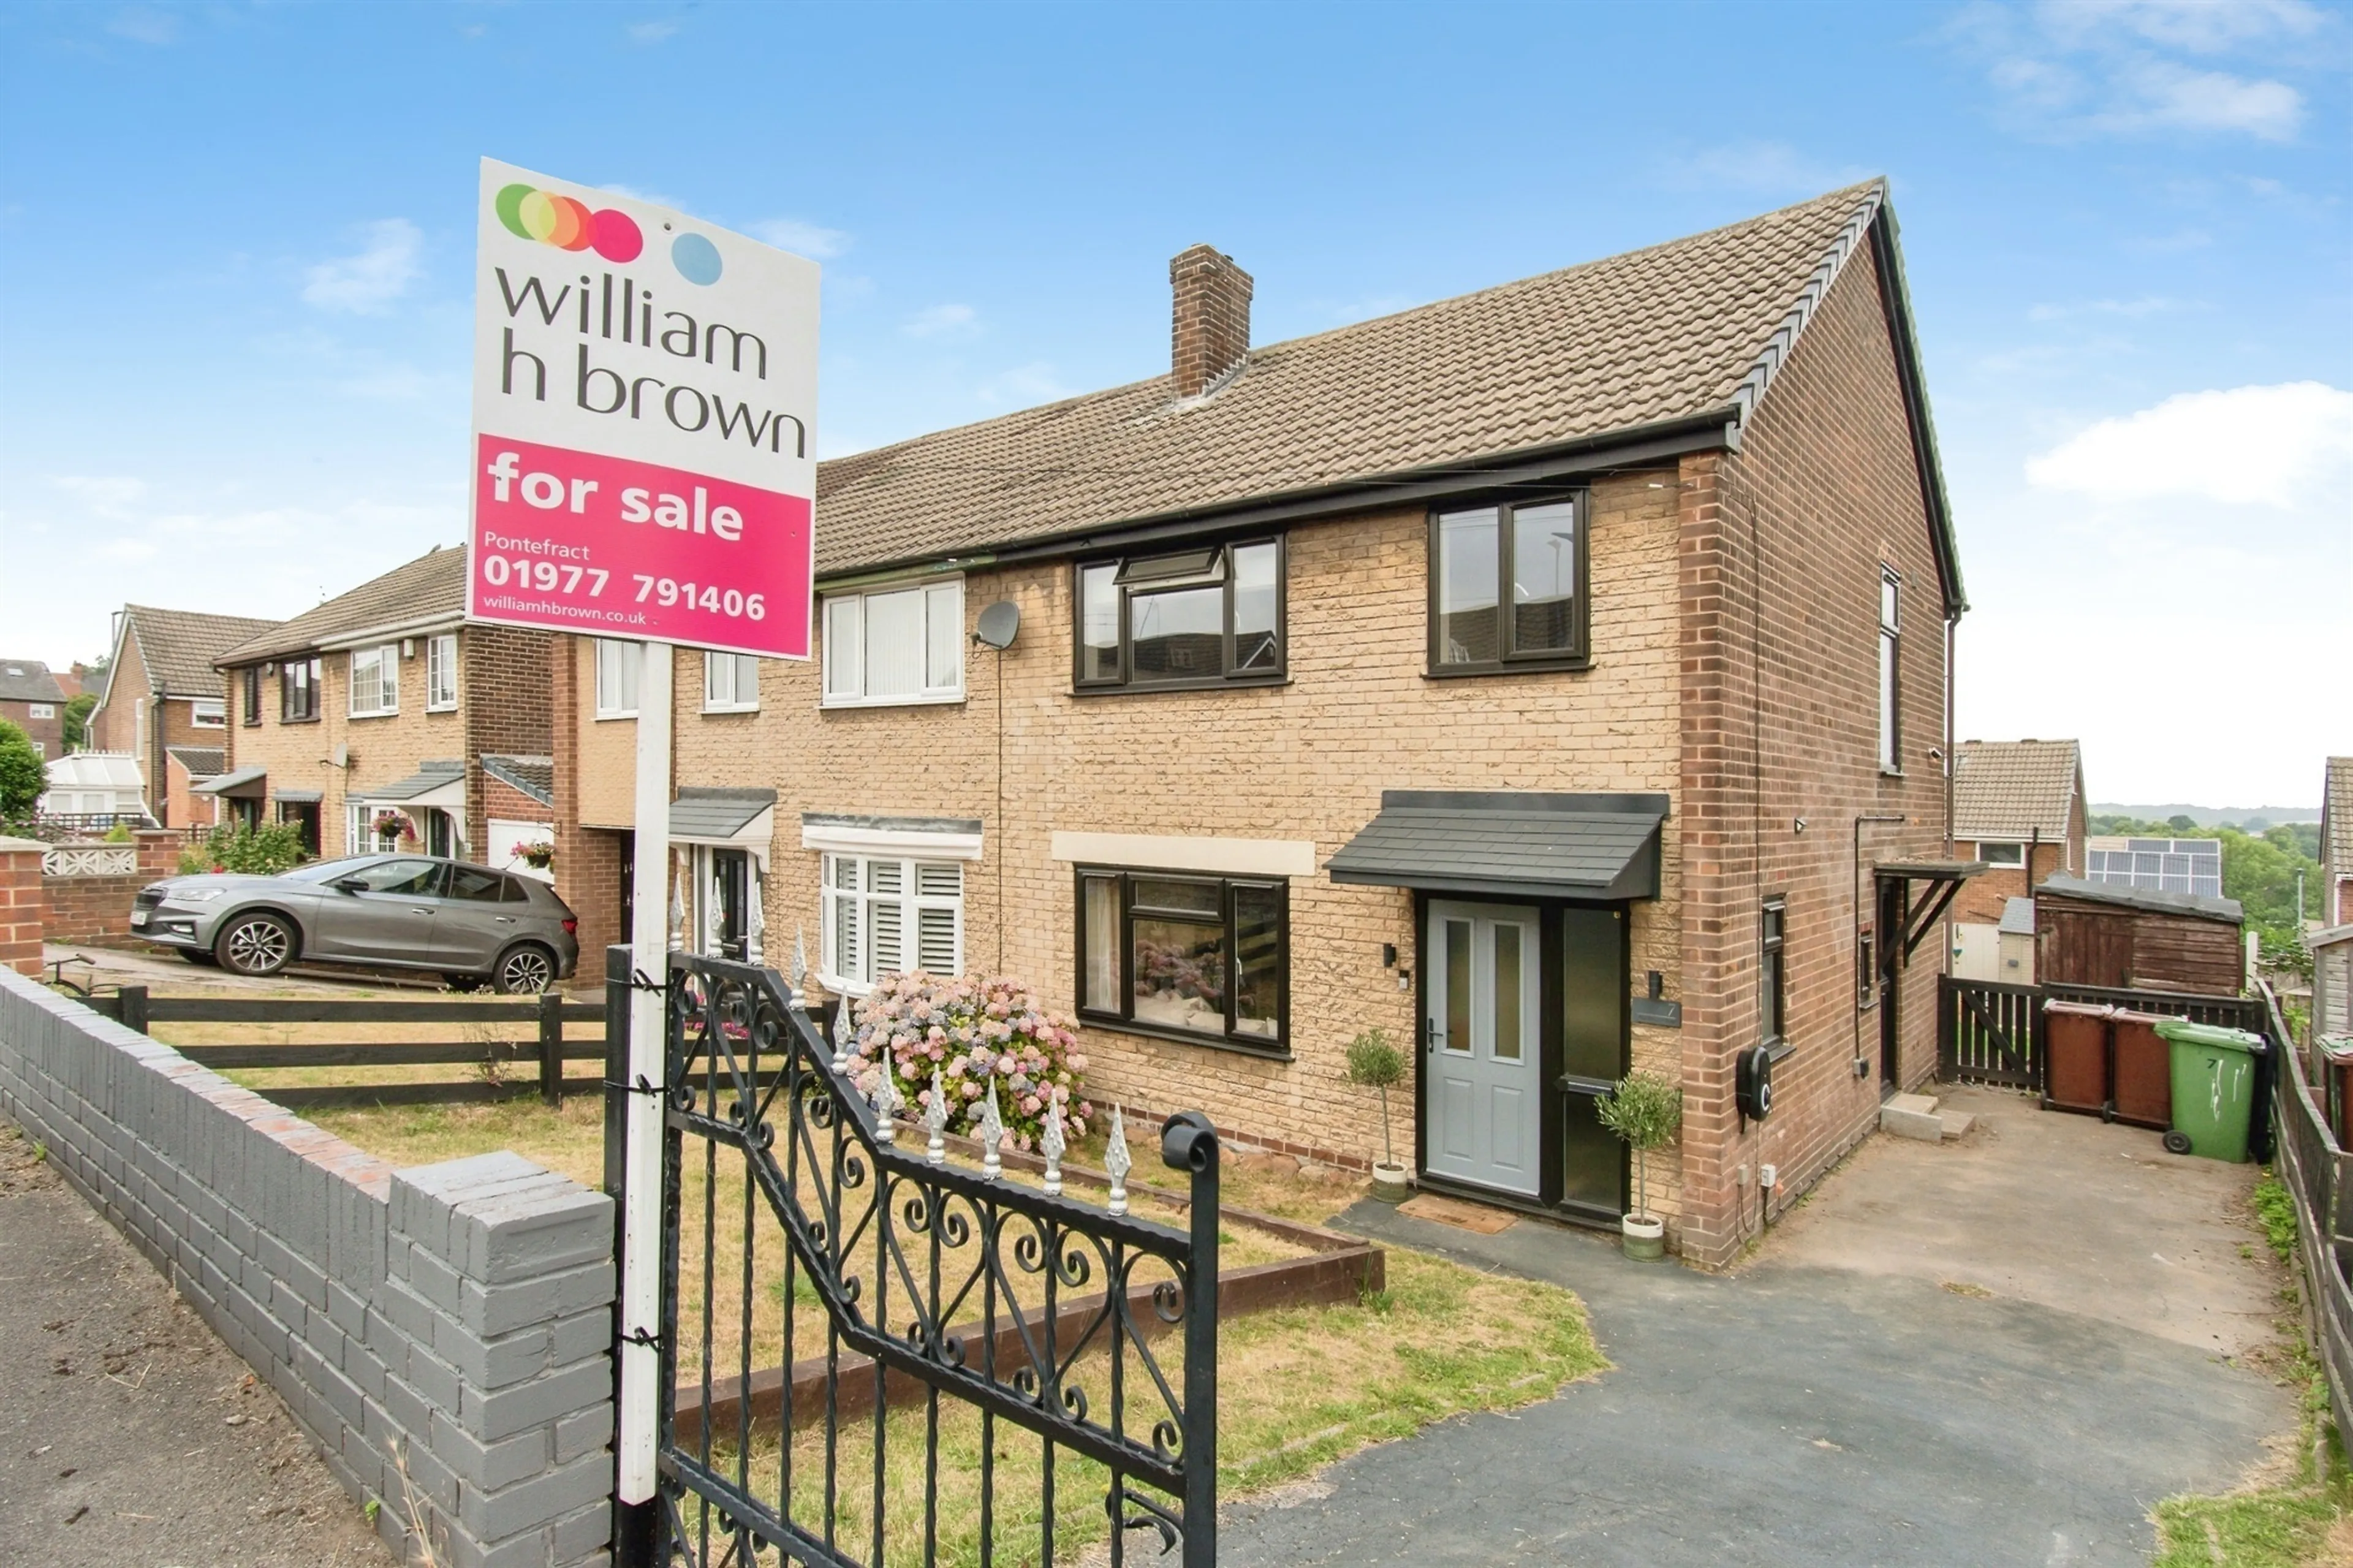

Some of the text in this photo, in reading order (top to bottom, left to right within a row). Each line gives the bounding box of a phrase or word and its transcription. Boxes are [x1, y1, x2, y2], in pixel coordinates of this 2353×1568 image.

[494, 267, 767, 381] william
[502, 326, 805, 459] h brown
[487, 452, 744, 542] for sale
[484, 531, 590, 561] Pontefract
[483, 555, 765, 621] 01977 791406
[483, 595, 646, 625] williamhbrown.co.uk
[1667, 1003, 1676, 1017] 7
